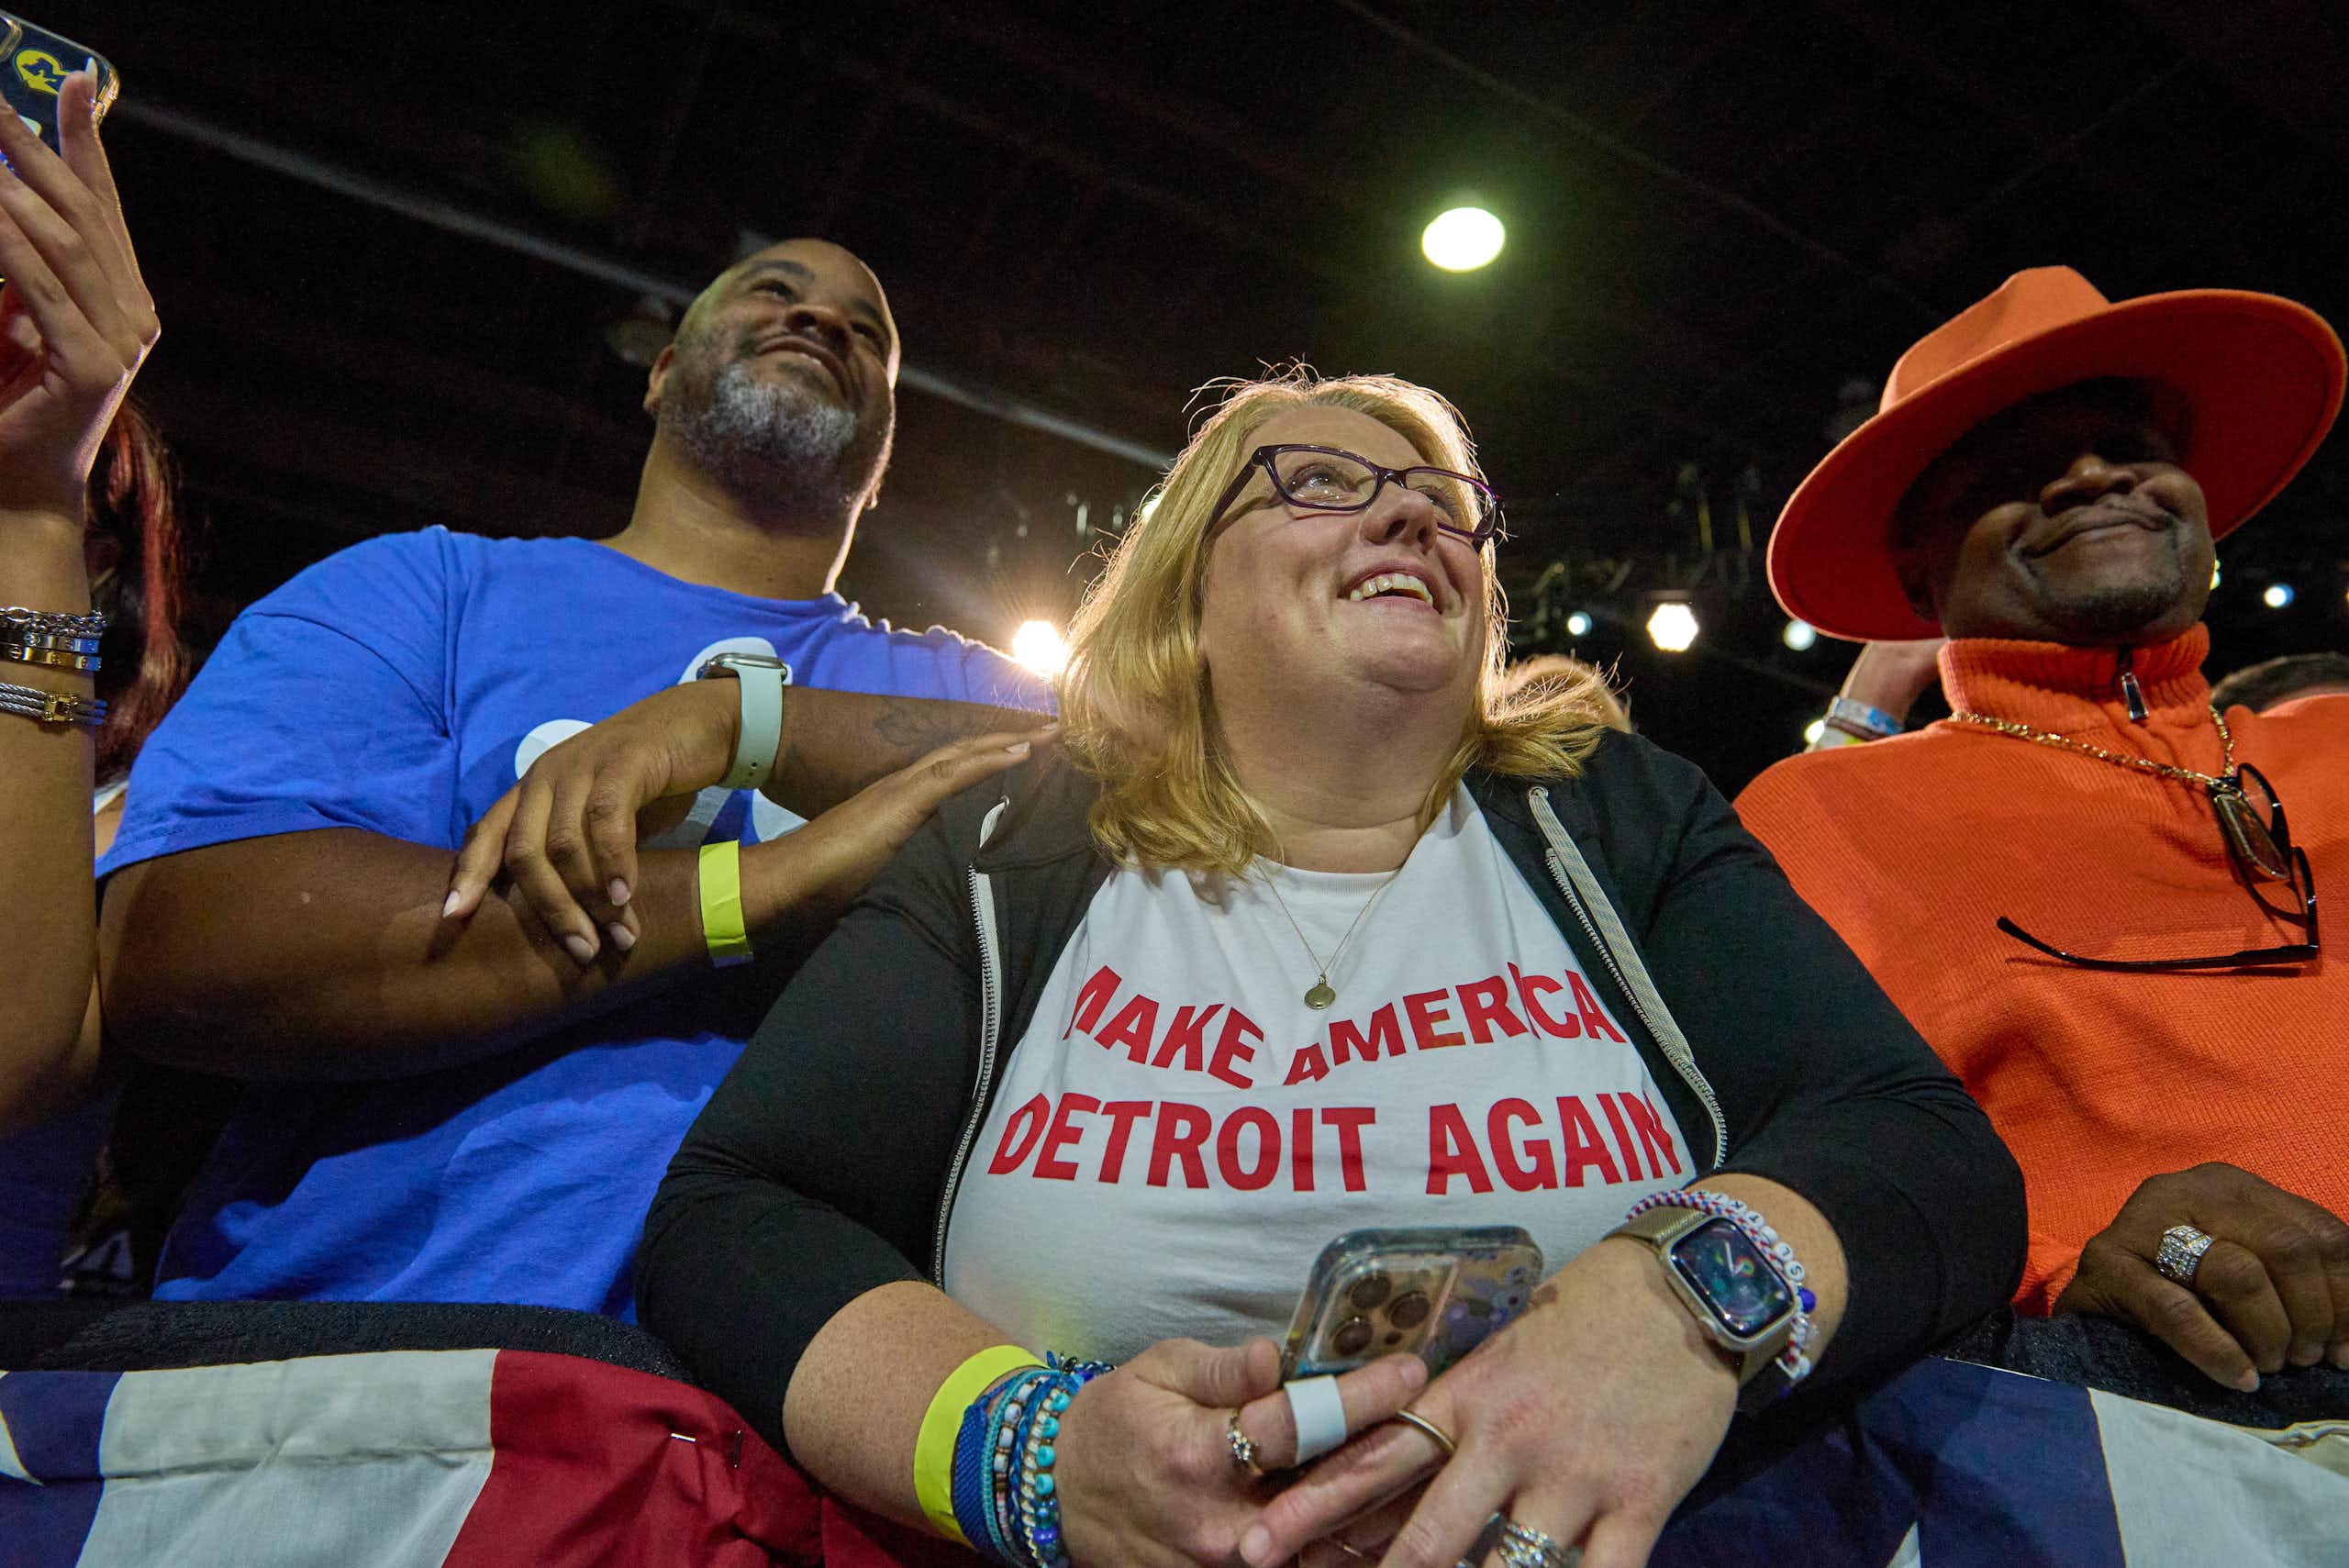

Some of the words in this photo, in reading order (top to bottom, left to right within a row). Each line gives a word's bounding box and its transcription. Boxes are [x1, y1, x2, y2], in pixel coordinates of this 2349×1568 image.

[1063, 965, 1264, 1089] MAKE
[1284, 962, 1627, 1085] AMERICA
[988, 1093, 1375, 1192] DETROIT
[1427, 1090, 1682, 1195] AGAIN
